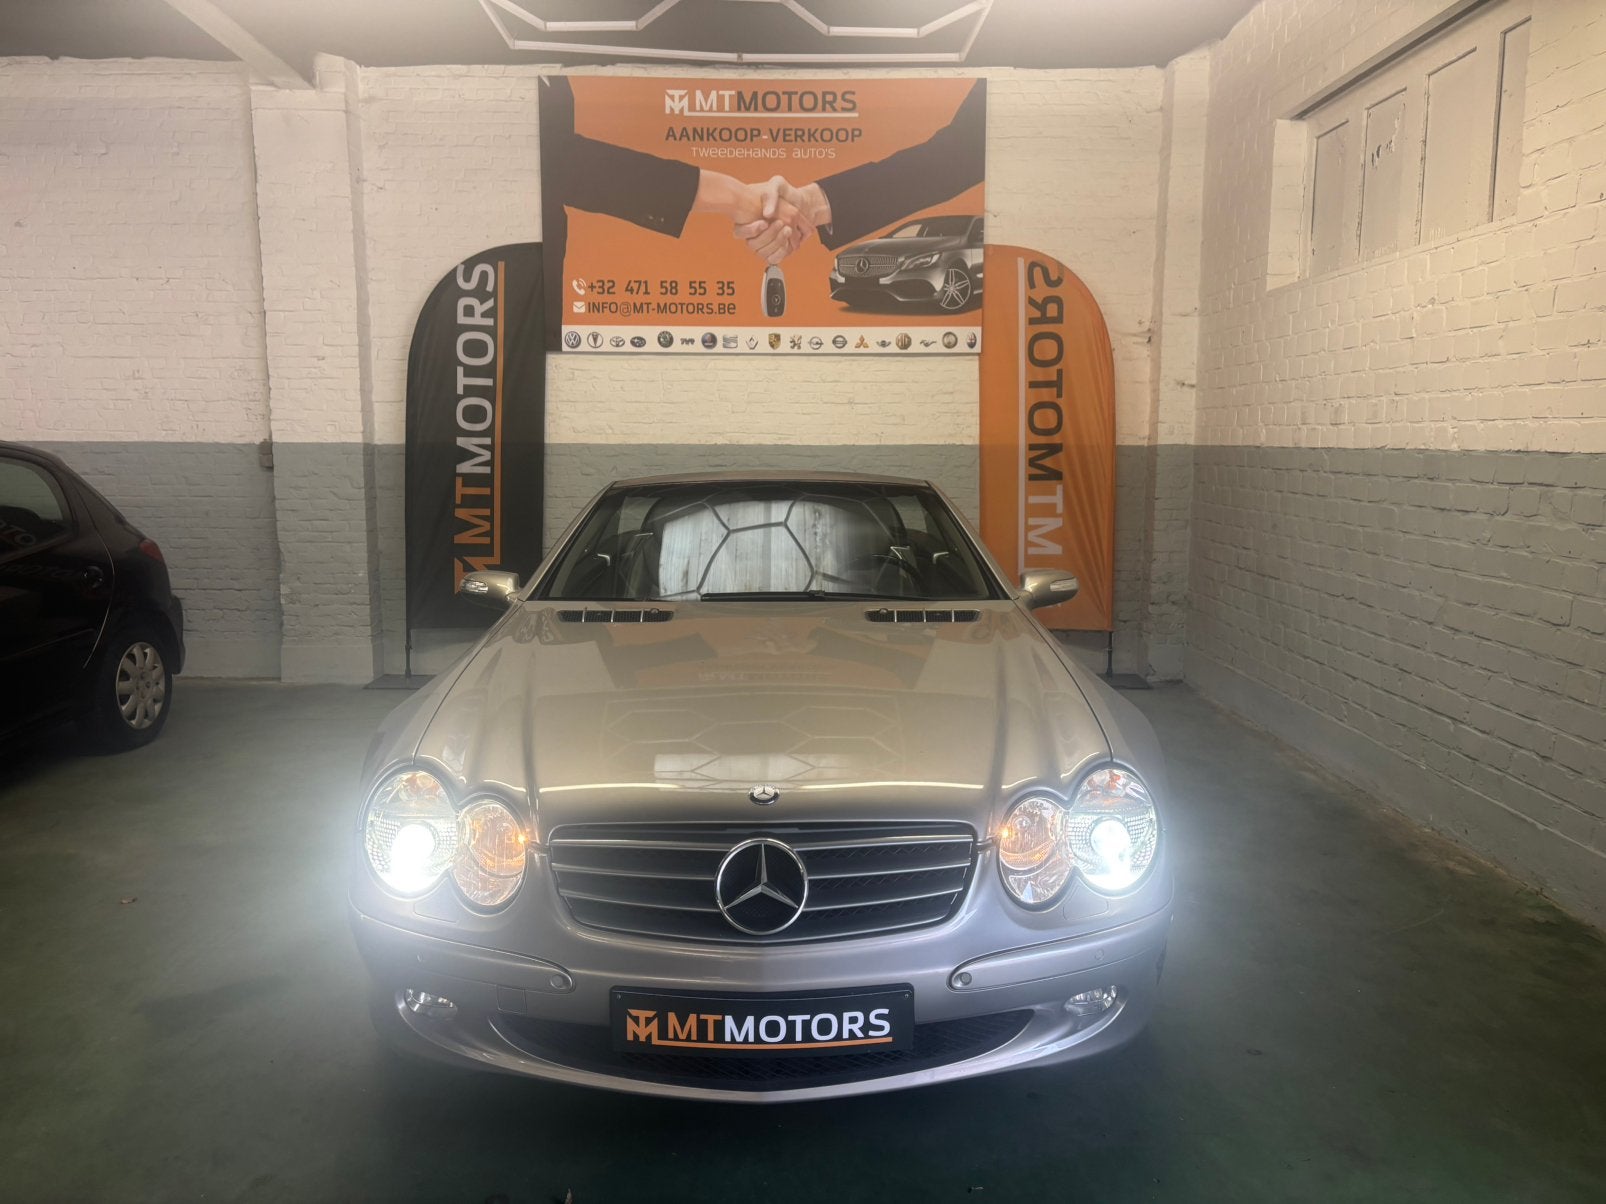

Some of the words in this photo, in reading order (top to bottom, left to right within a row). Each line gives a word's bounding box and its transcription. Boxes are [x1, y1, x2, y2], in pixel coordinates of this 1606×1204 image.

[587, 280, 616, 295] +32
[625, 280, 651, 295] 471
[660, 280, 678, 296] 58
[688, 281, 707, 296] 55
[716, 281, 735, 296] 35
